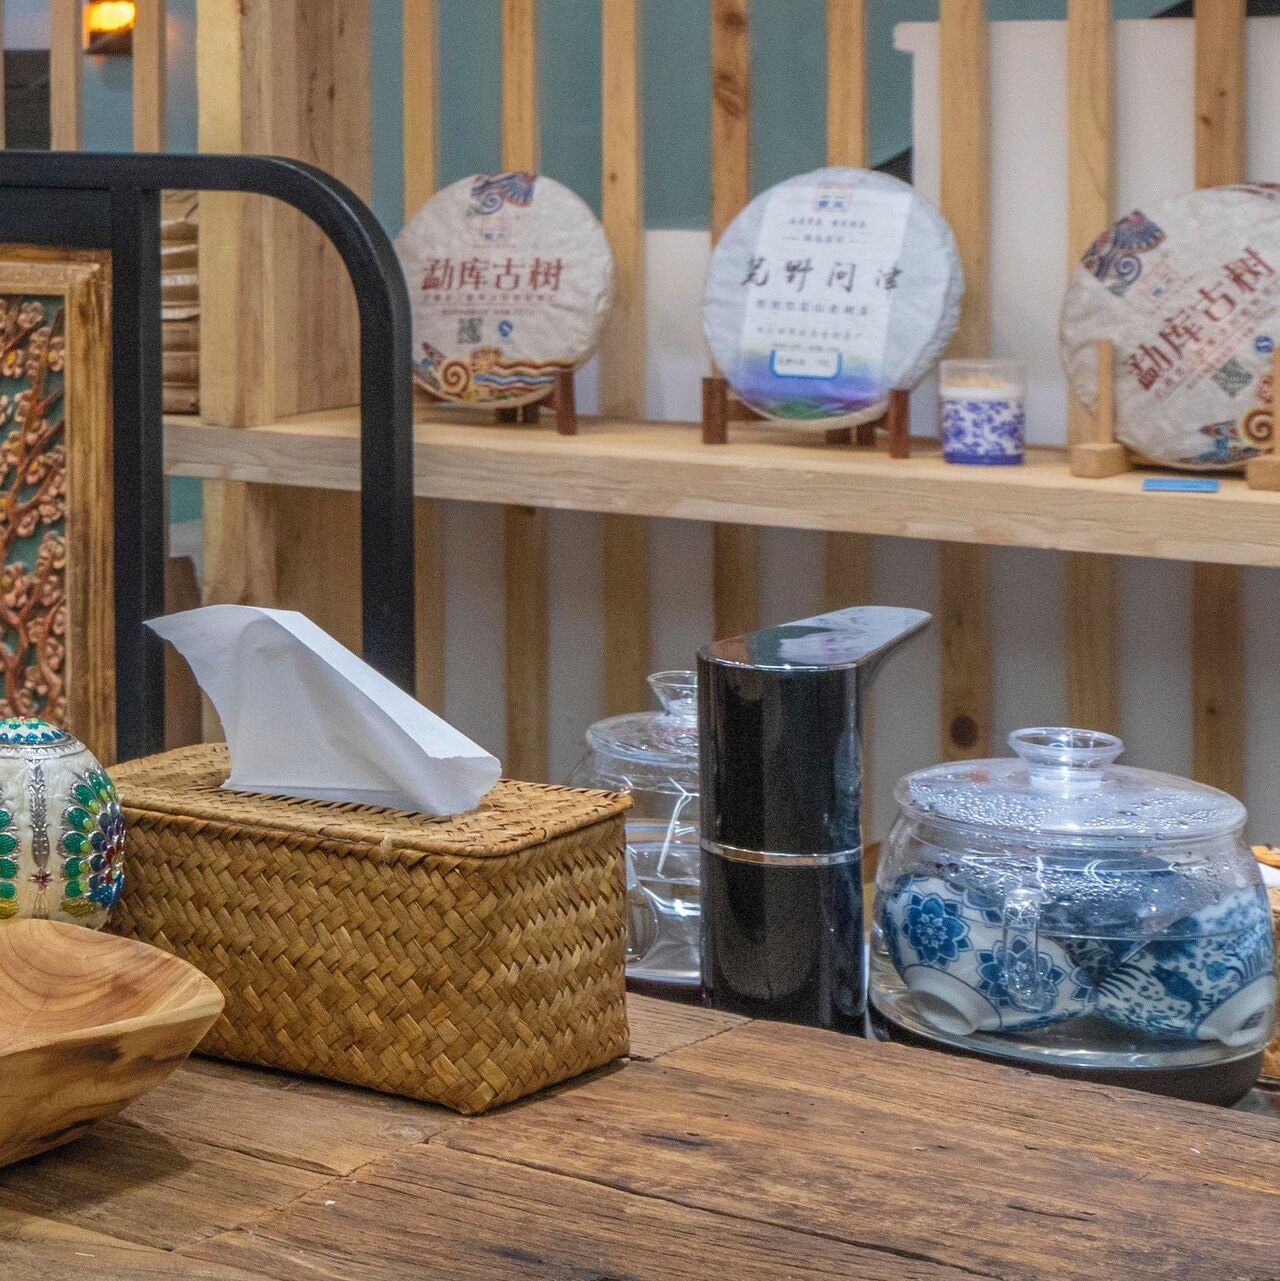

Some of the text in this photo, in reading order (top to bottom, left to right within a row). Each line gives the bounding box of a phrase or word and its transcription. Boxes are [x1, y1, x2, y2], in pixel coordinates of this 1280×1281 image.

[421, 257, 564, 291] 勐库古树
[1127, 246, 1275, 391] 勐库古树
